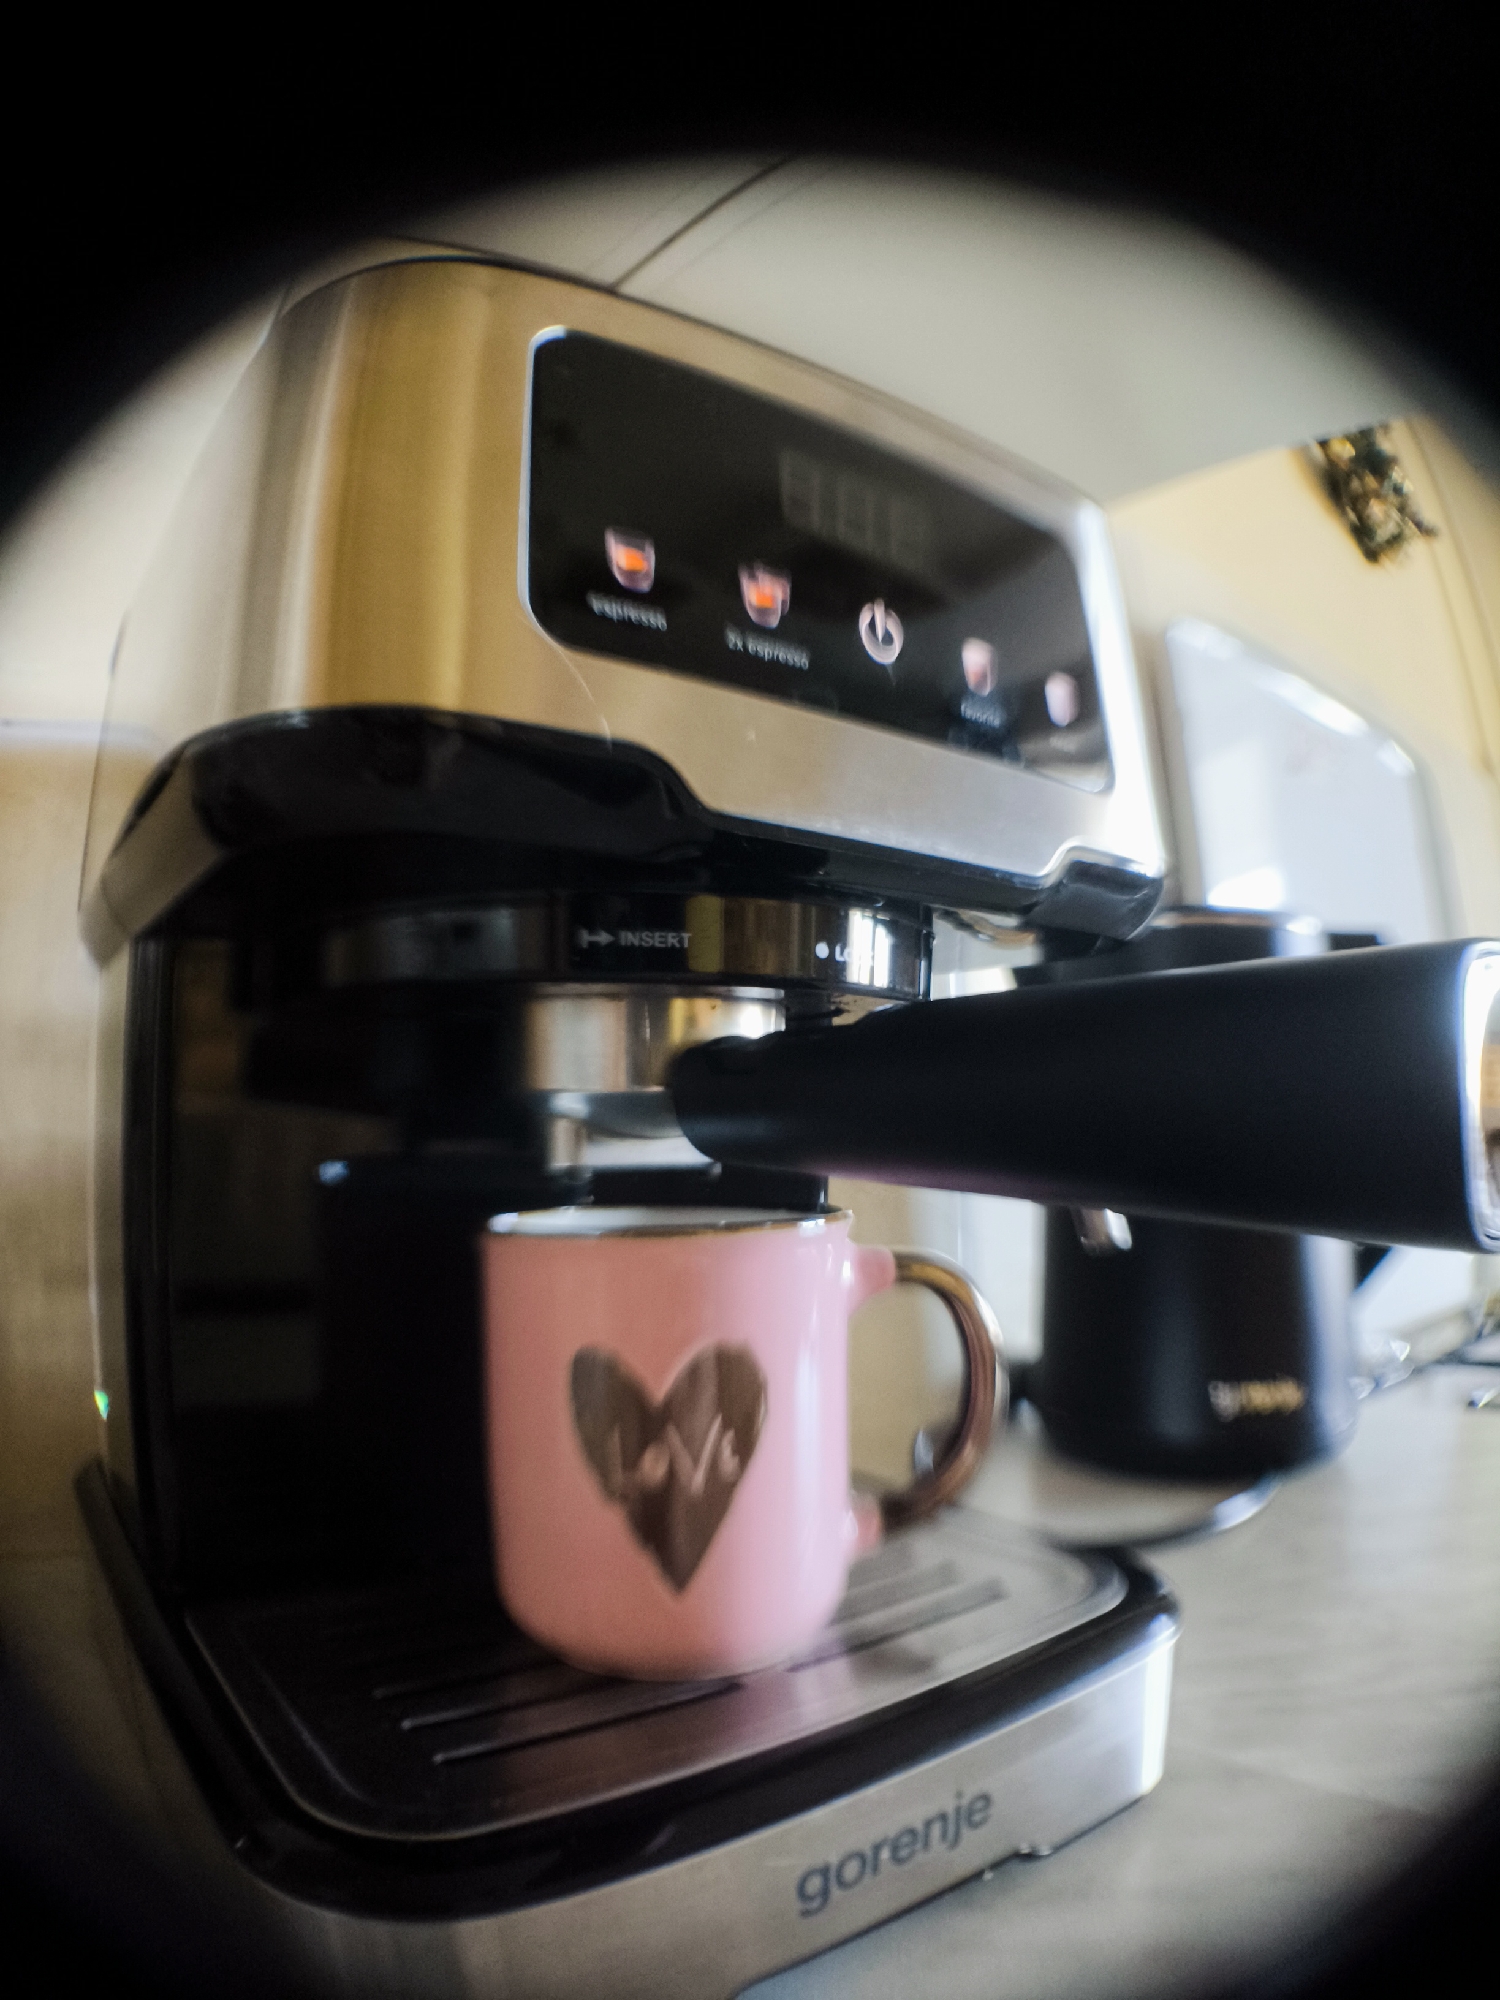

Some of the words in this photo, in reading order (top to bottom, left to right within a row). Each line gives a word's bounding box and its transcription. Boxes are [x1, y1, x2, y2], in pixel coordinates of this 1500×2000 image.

[746, 634, 810, 670] espresso
[619, 928, 692, 950] INSERT
[796, 1789, 992, 1918] gorenje
